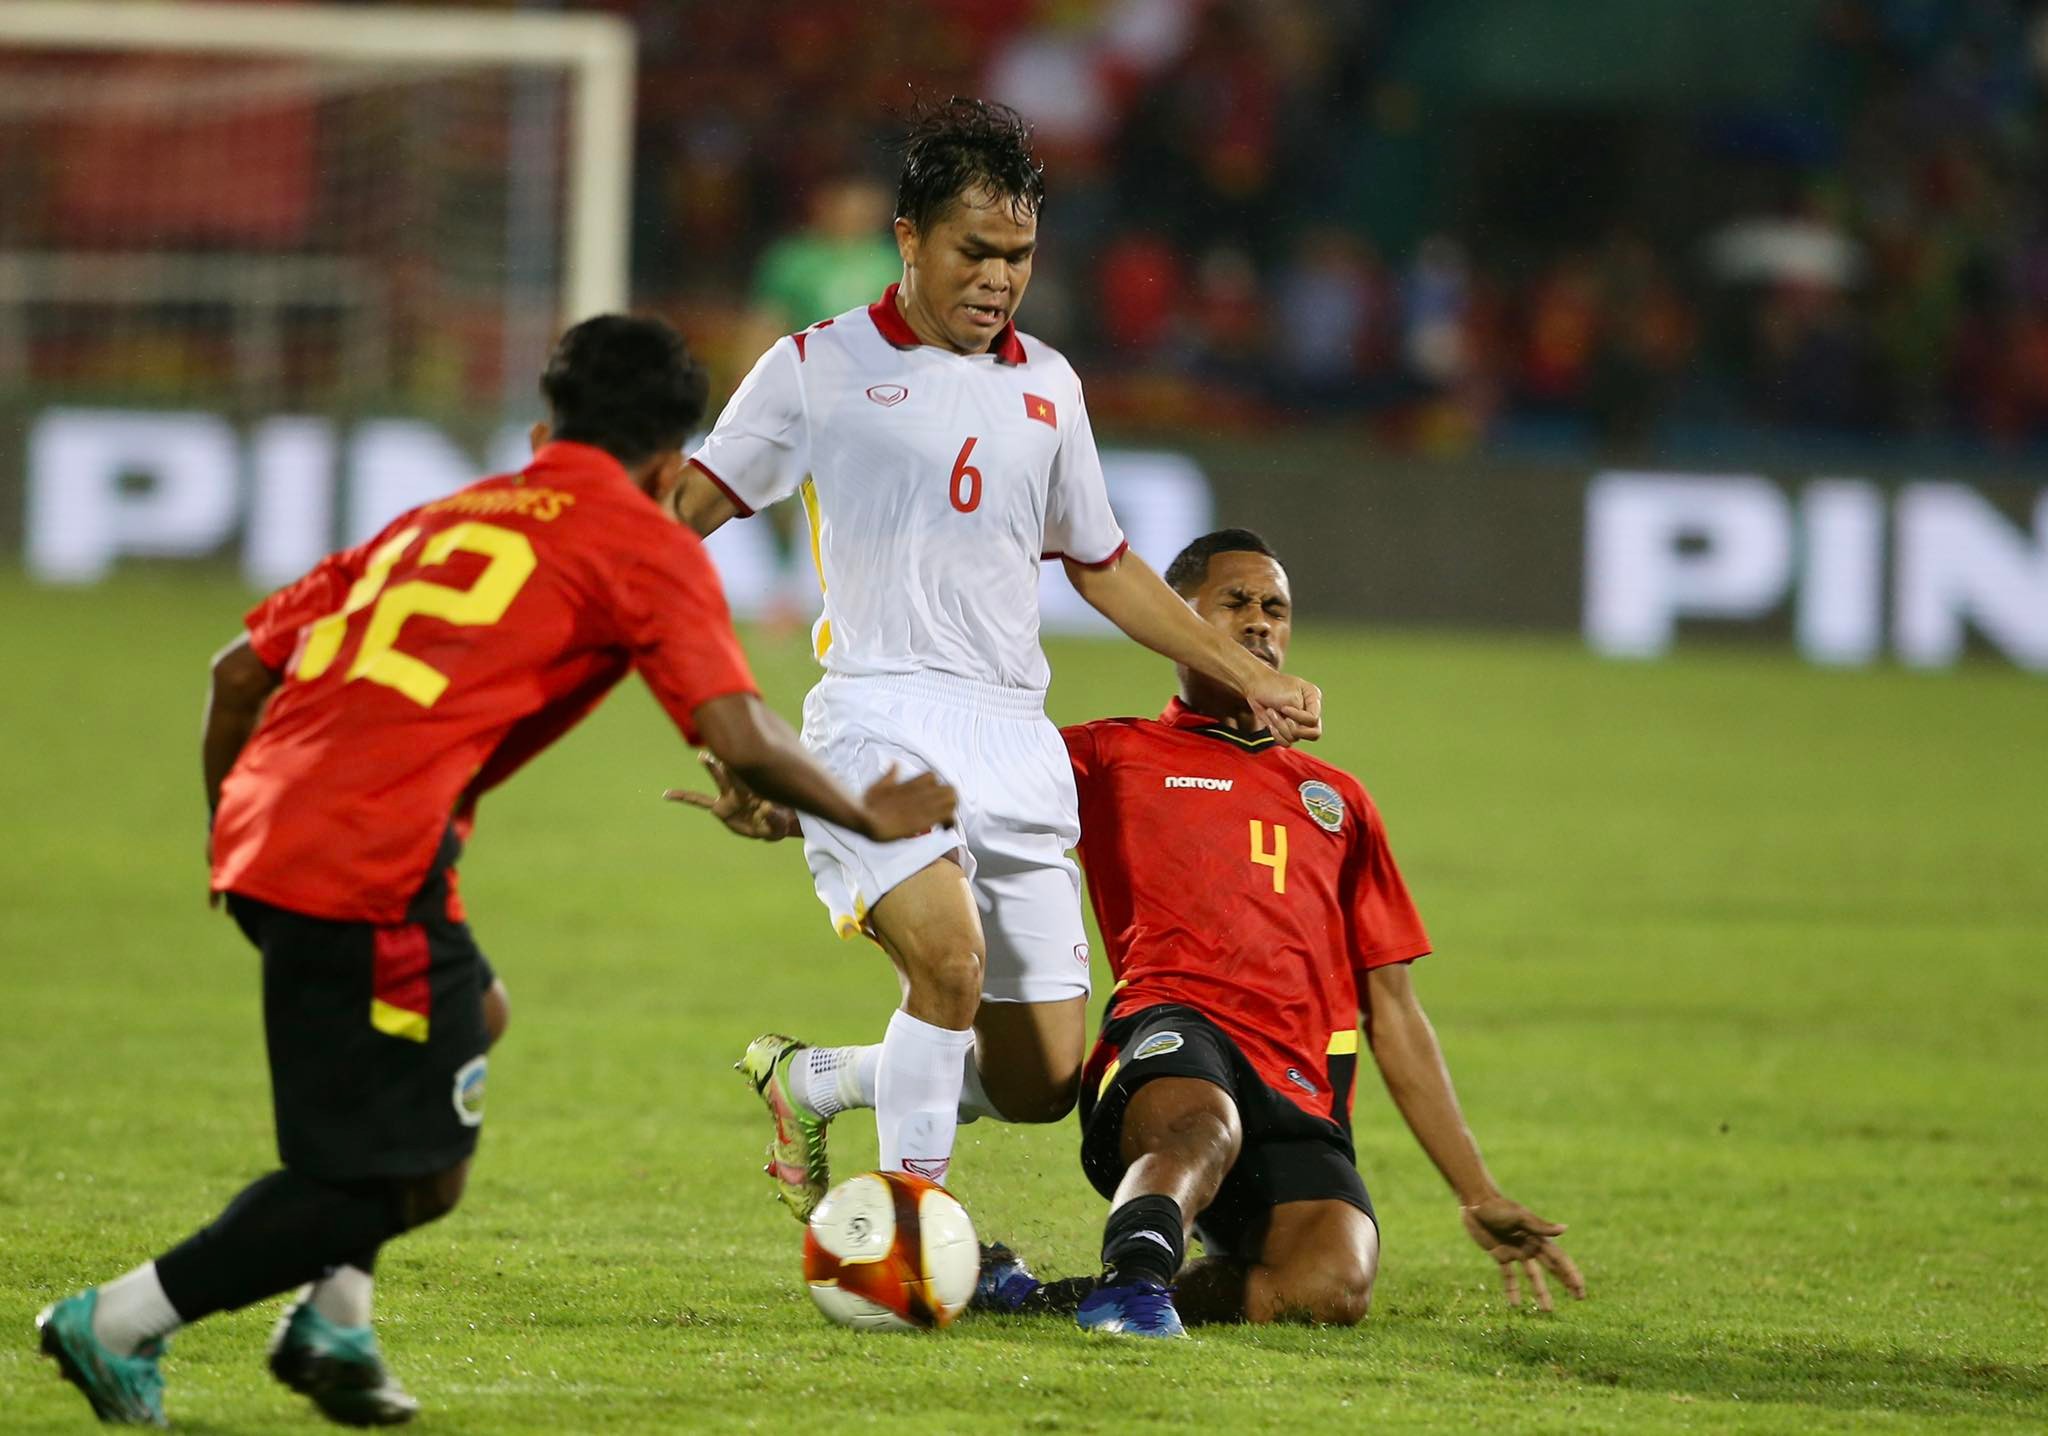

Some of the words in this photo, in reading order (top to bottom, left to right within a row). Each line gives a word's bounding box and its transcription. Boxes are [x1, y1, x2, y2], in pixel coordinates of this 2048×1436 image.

[949, 437, 982, 513] 6
[286, 522, 538, 708] 12
[1165, 777, 1233, 791] narrow
[1250, 820, 1287, 893] 4
